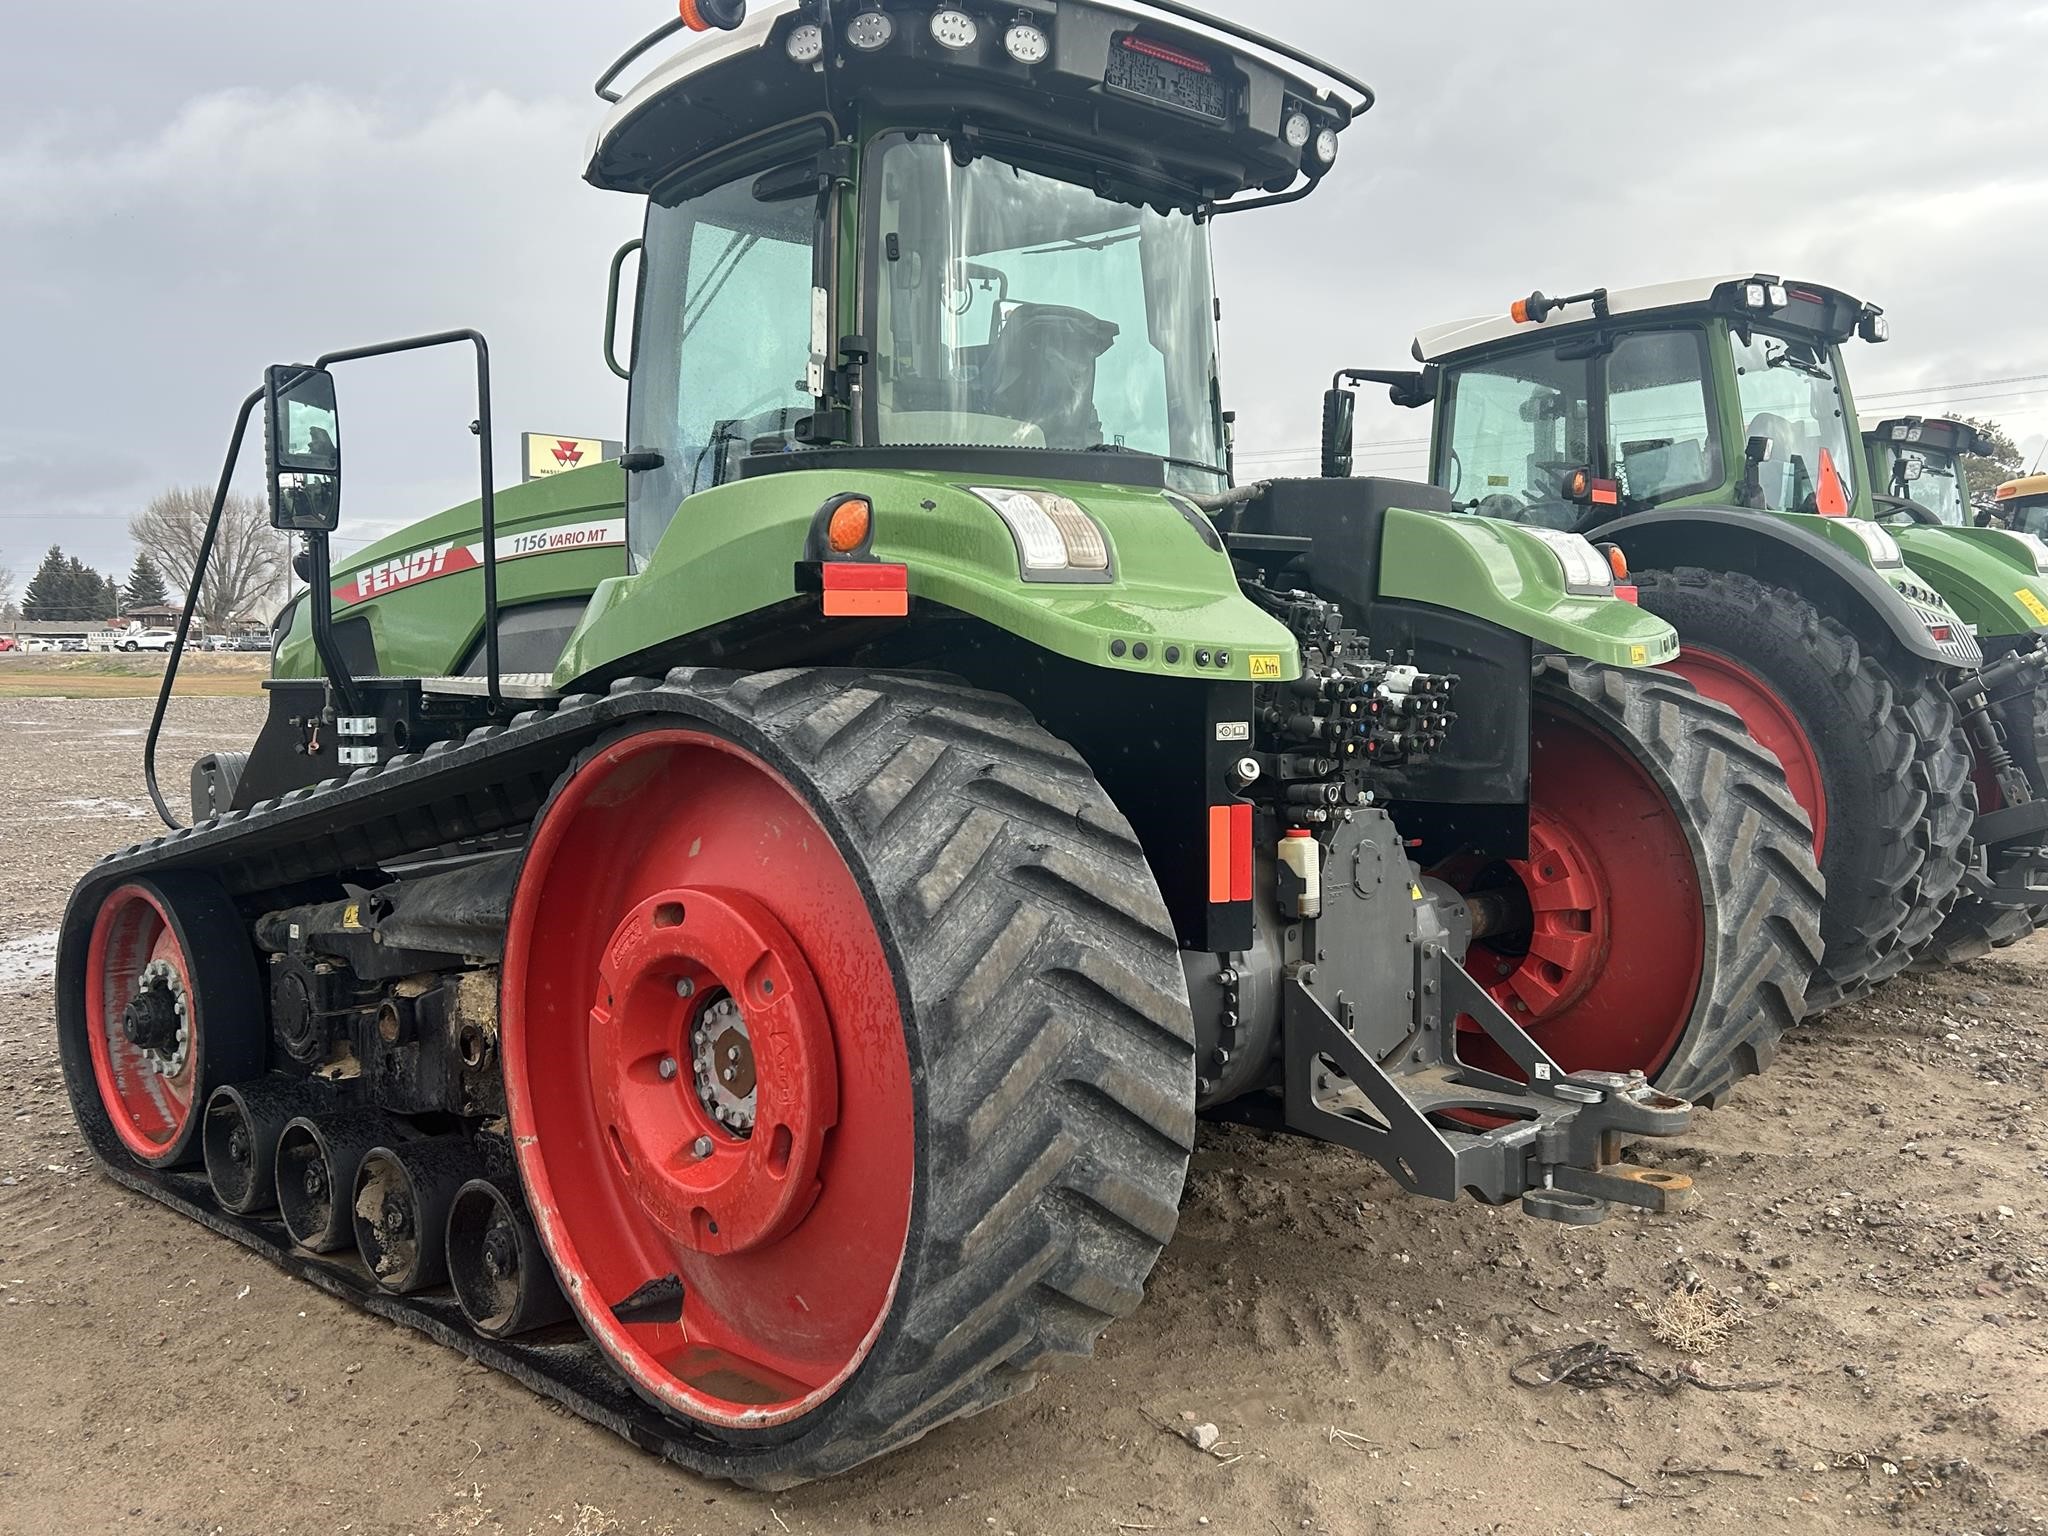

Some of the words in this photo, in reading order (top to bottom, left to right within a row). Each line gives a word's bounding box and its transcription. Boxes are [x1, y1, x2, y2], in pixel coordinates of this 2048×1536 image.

[514, 532, 547, 553] 1156
[549, 531, 585, 547] VARIO
[587, 528, 607, 542] MT
[356, 541, 454, 597] FENDT
